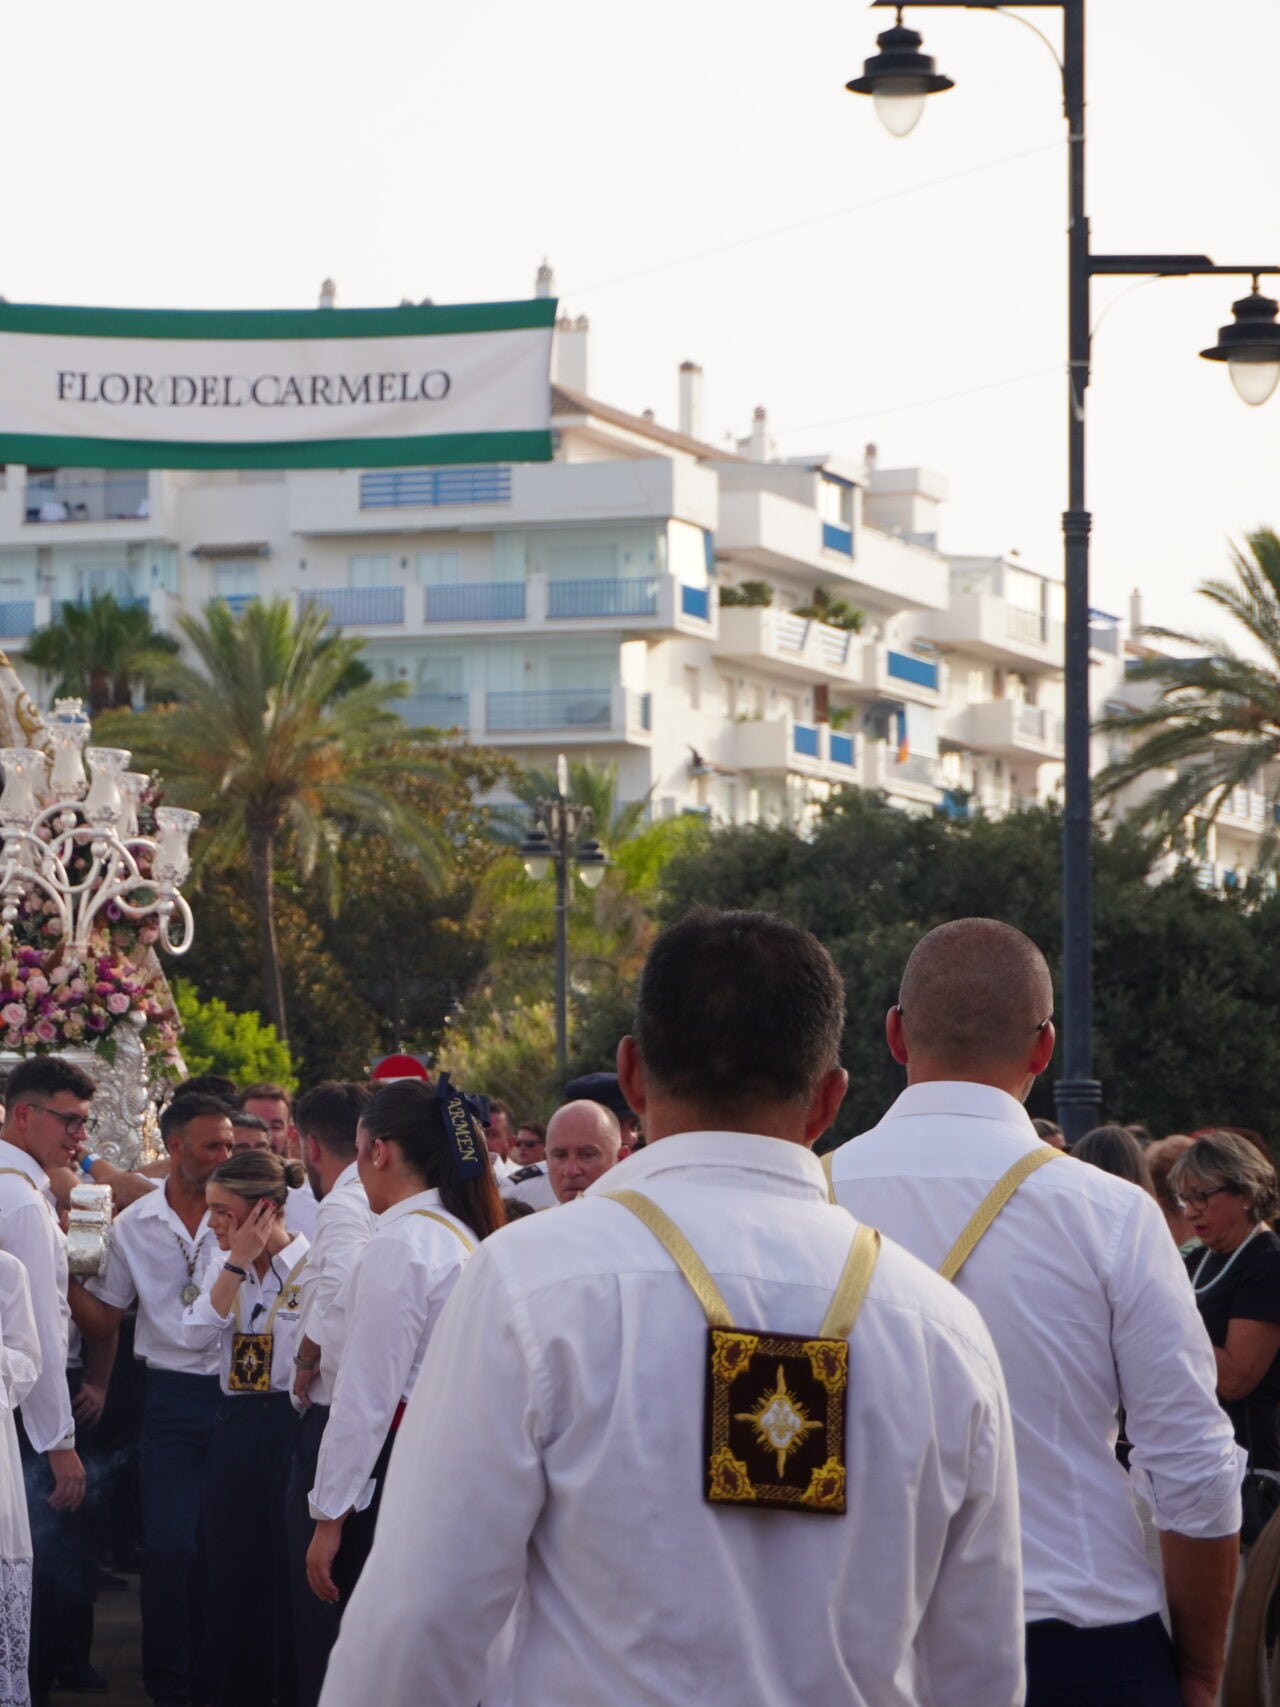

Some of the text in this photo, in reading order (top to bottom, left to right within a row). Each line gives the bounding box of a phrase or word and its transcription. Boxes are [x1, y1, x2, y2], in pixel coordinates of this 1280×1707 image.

[57, 369, 451, 408] FLOR DEL CARMELO
[448, 1097, 478, 1162] ARMEN
